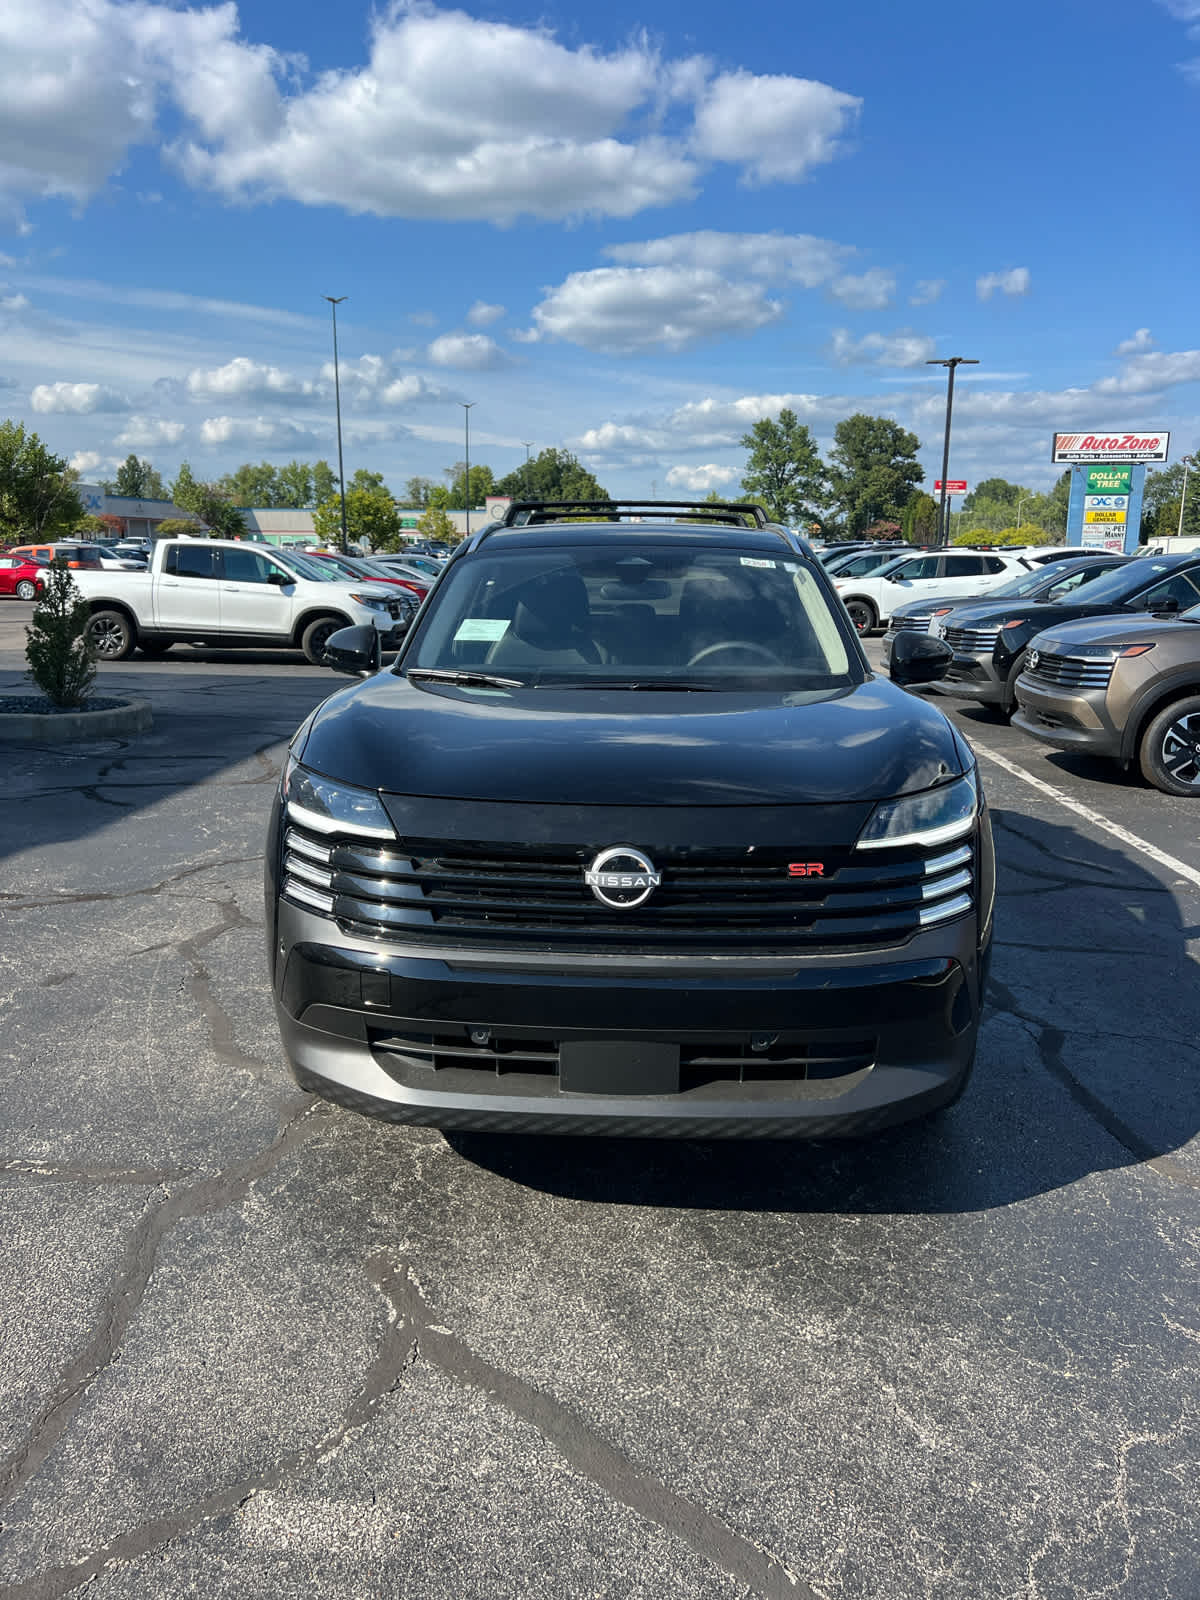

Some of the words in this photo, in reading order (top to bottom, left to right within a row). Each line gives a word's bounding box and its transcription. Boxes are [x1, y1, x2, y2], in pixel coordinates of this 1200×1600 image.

[1079, 436, 1160, 450] AutoZone
[1090, 472, 1128, 480] DOLLAR
[788, 864, 825, 876] SR
[586, 875, 661, 887] NISSAN
